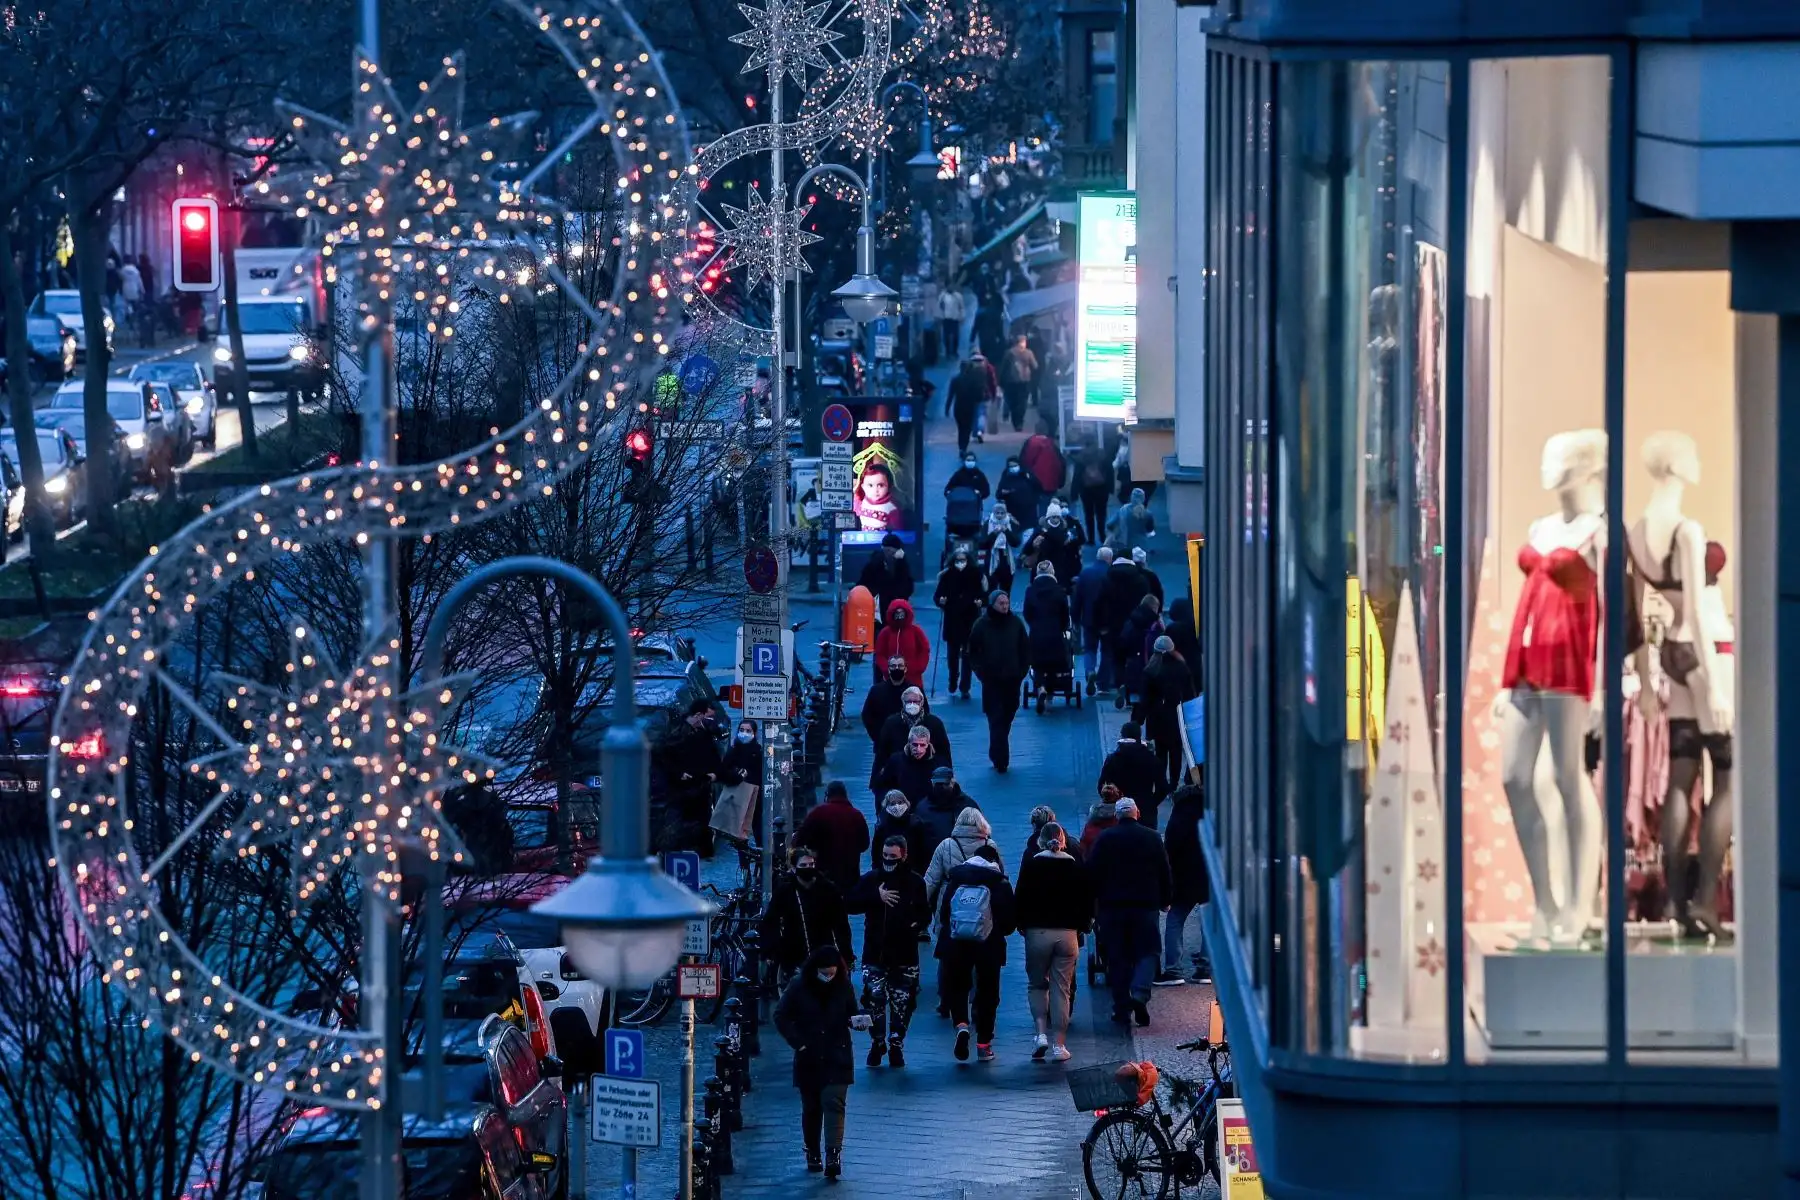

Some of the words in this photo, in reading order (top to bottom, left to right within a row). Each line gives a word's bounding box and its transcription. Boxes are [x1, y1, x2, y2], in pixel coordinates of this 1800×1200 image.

[752, 627, 772, 636] Mo-Fr
[759, 648, 773, 671] P
[615, 1036, 633, 1071] P
[613, 1108, 633, 1120] Zone
[638, 1111, 649, 1120] 24
